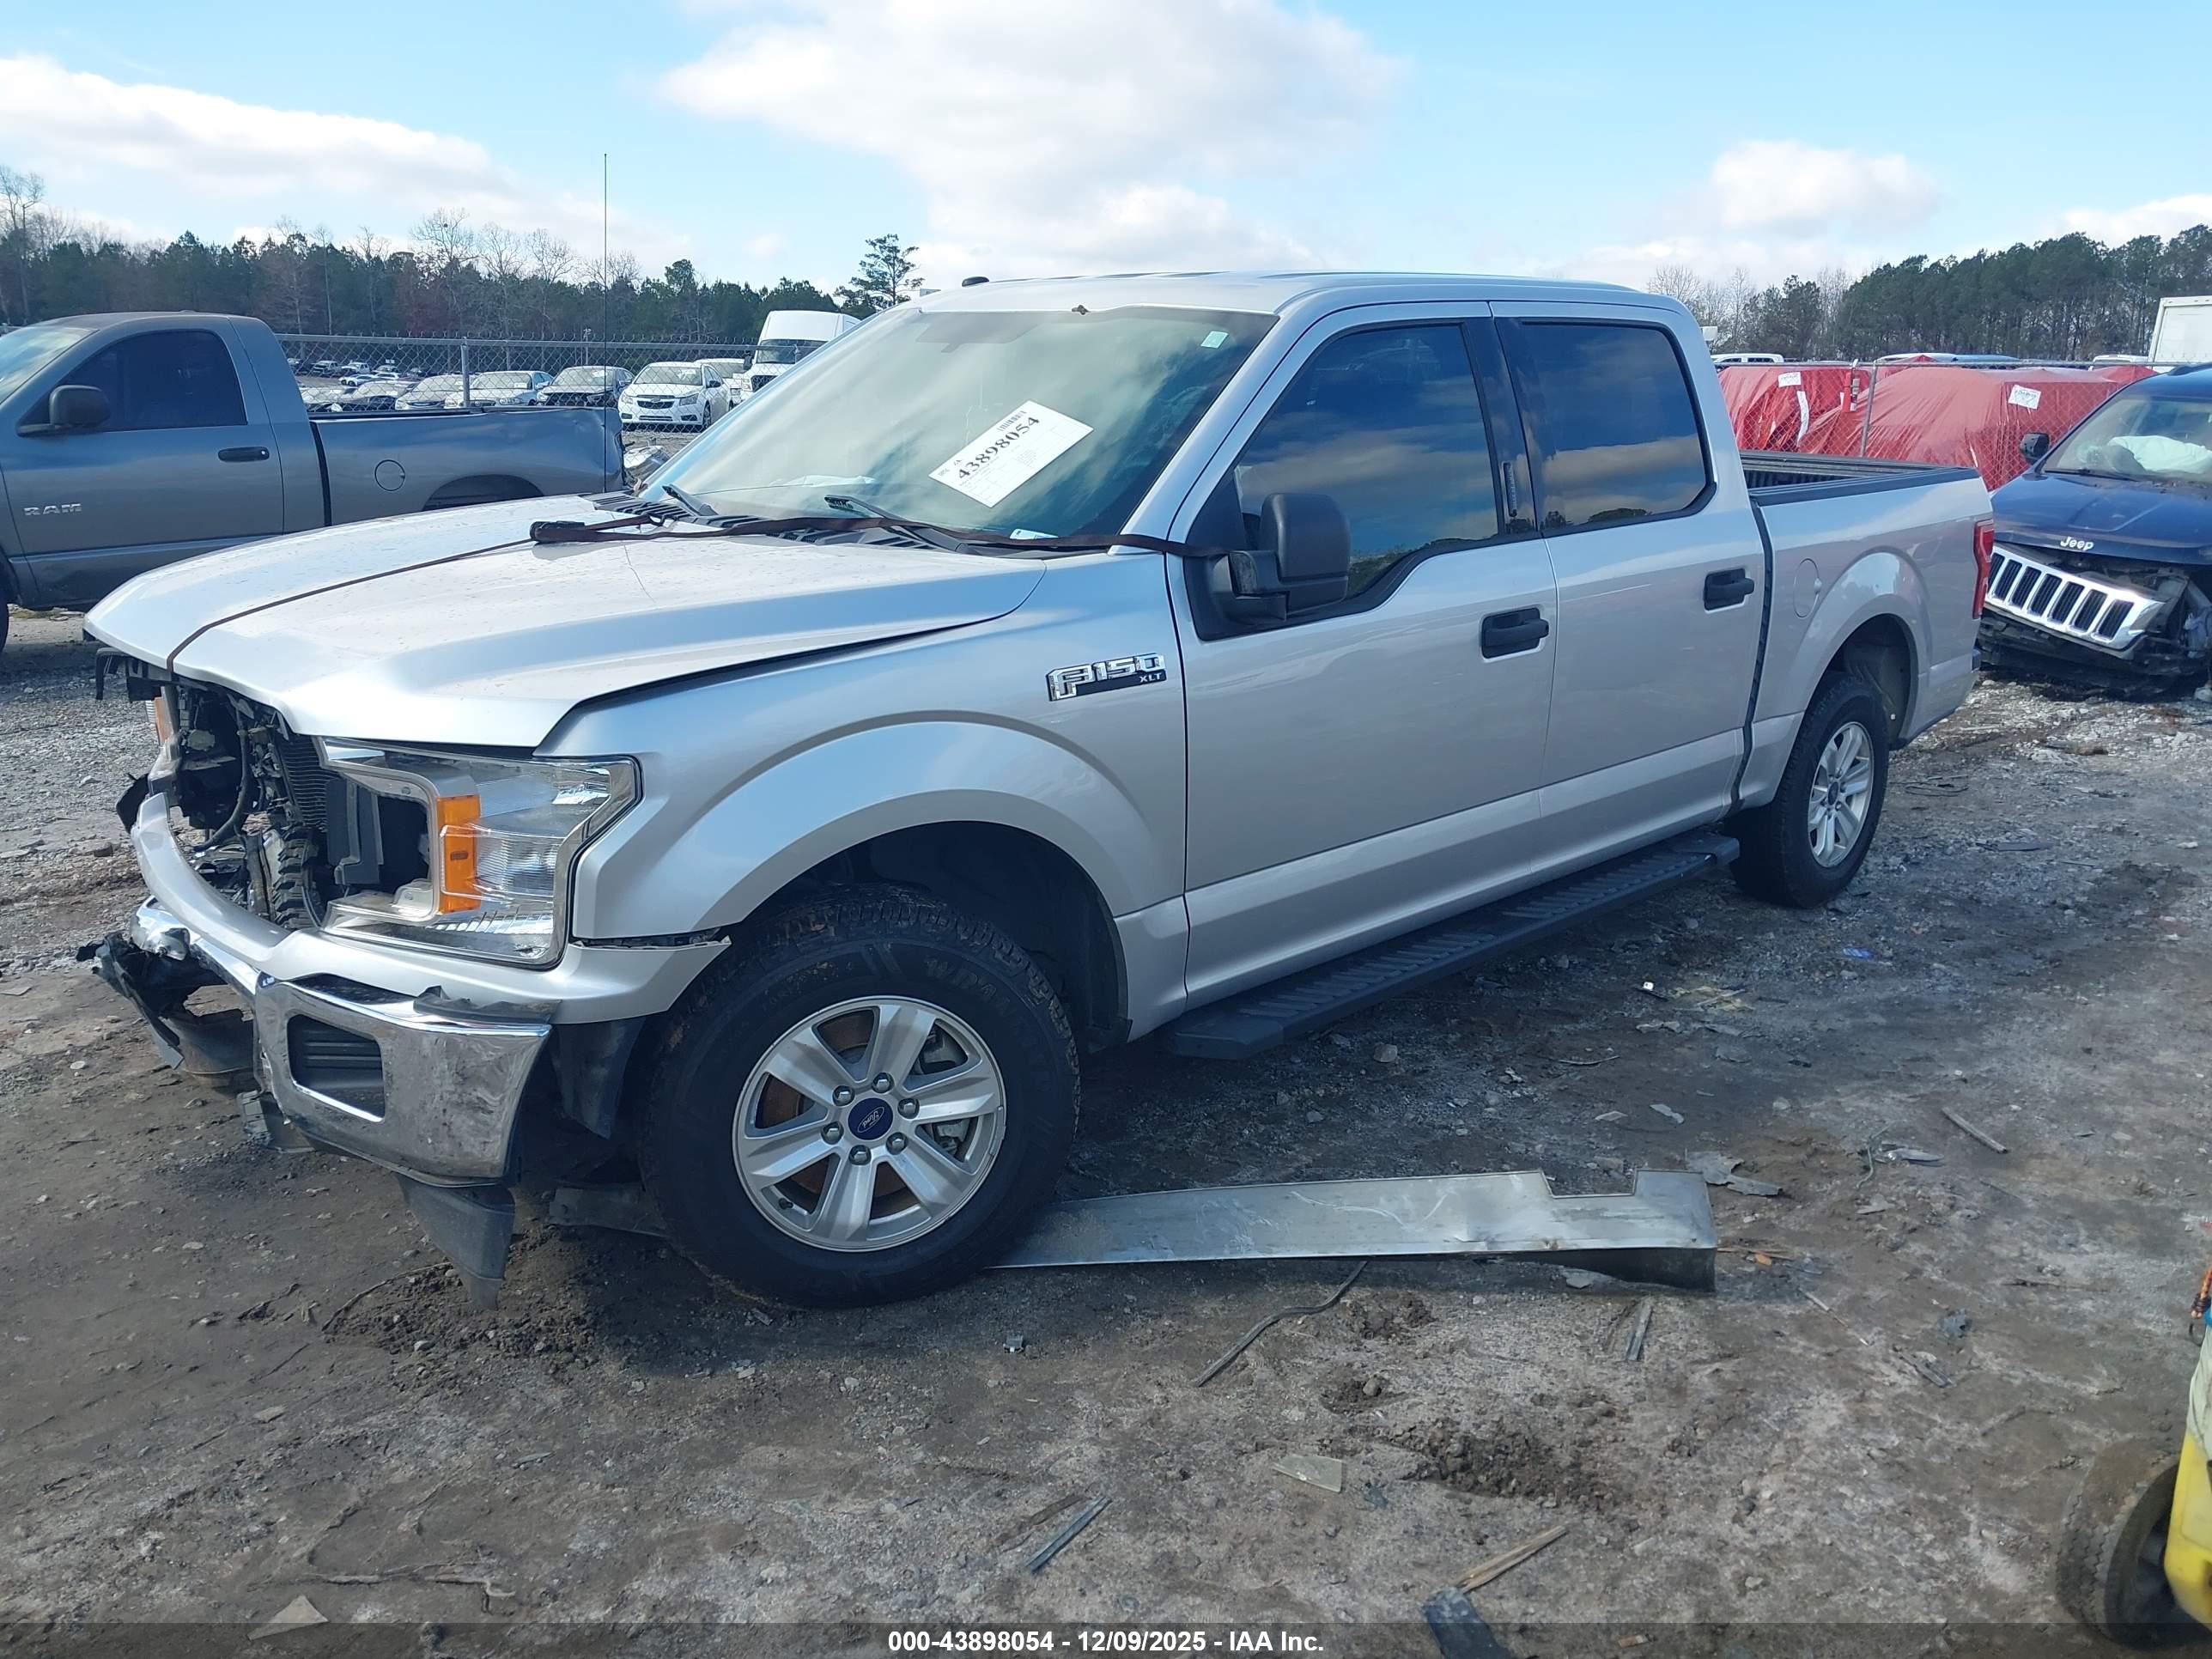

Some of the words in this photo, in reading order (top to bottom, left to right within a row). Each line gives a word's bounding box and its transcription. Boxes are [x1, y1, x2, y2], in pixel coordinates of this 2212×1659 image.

[957, 416, 1040, 479] 43898054
[24, 503, 82, 515] RAM
[2060, 536, 2094, 551] Jeep
[1046, 653, 1166, 702] F150
[1139, 672, 1162, 684] XLT
